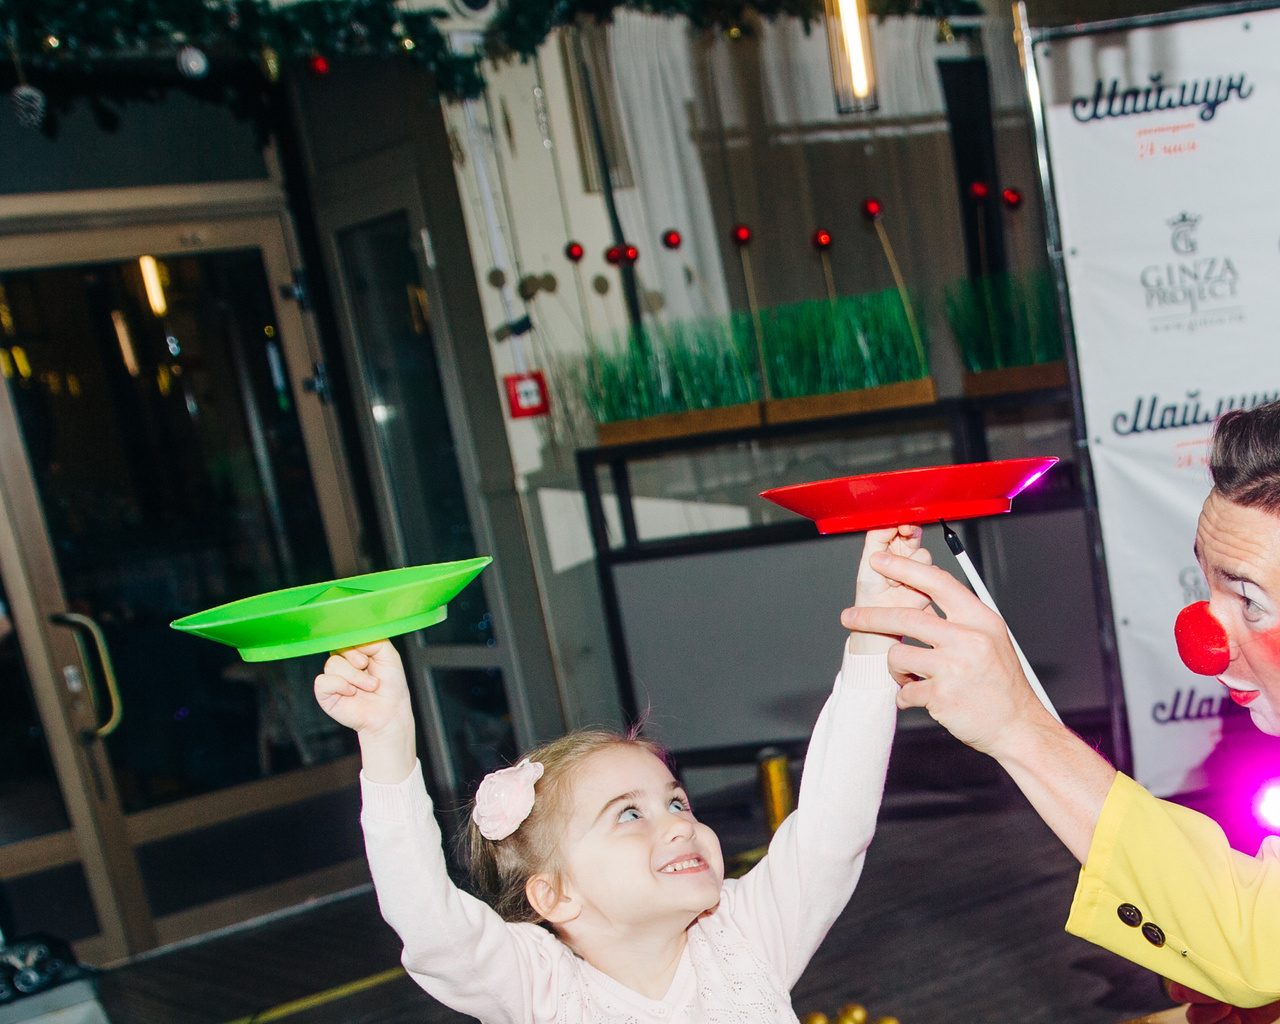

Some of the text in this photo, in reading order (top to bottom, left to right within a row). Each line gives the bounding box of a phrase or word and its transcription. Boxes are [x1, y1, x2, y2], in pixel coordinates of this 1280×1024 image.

[1072, 72, 1254, 122] Маймун
[1140, 257, 1239, 290] GINZA
[1145, 280, 1238, 316] PROJECT
